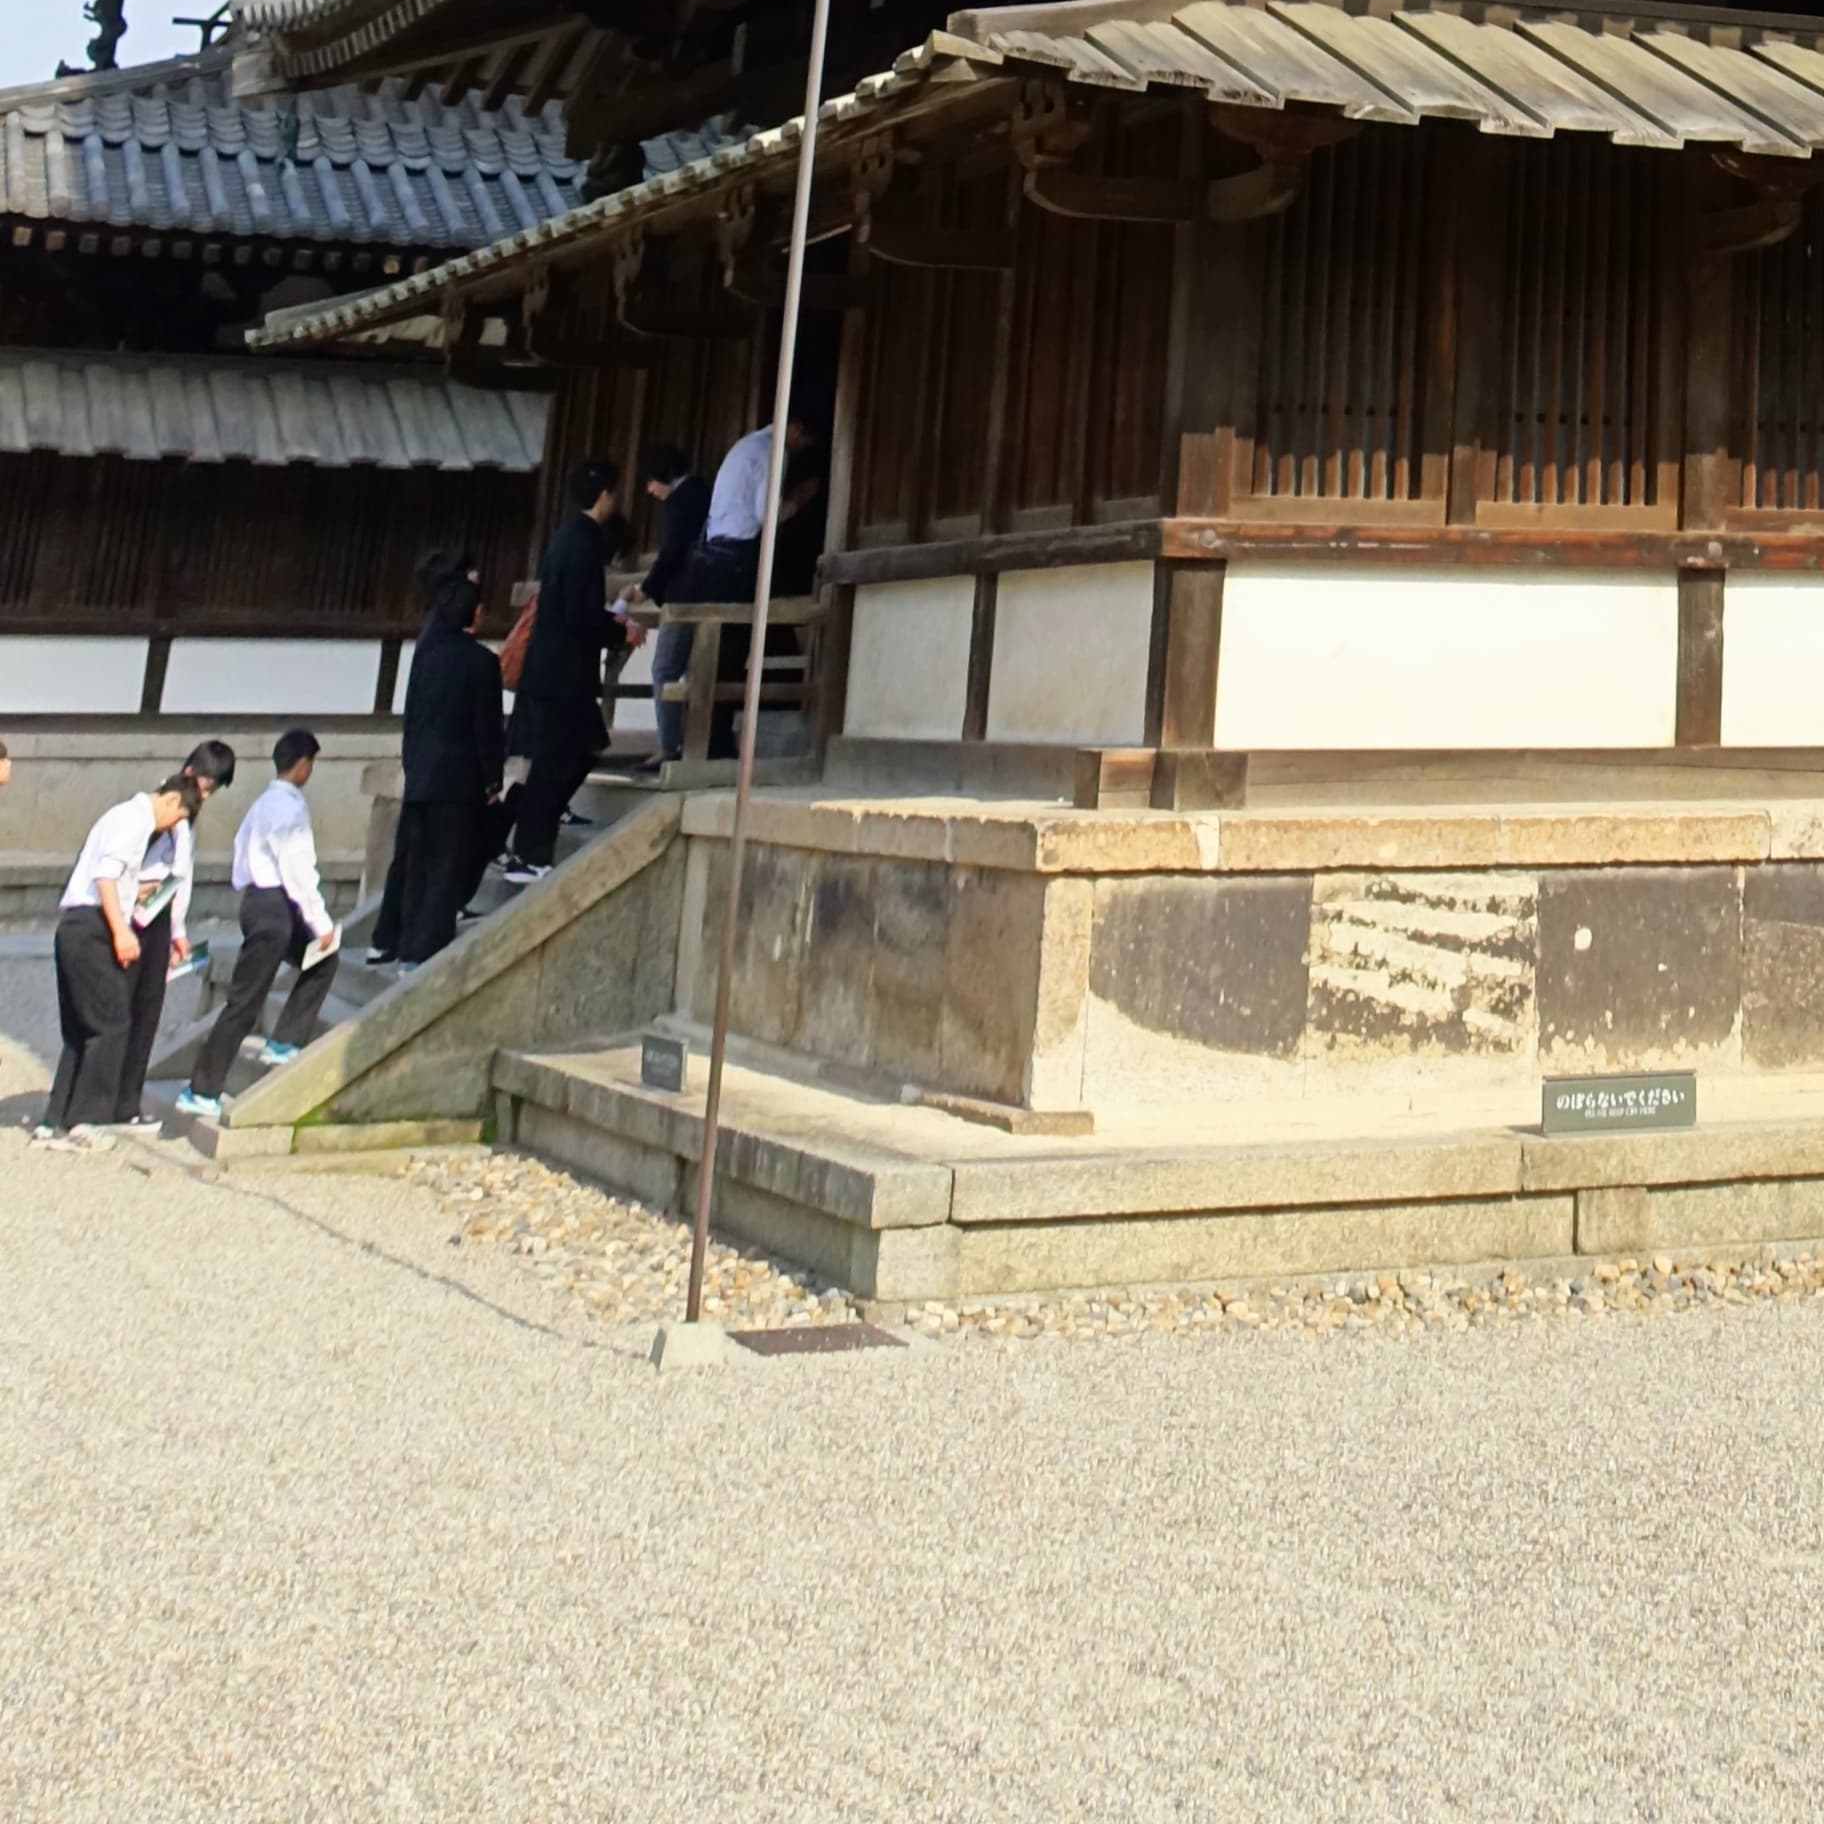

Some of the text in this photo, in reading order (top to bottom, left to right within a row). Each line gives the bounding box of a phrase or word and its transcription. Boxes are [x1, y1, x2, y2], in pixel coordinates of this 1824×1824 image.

[1556, 1087, 1685, 1110] のぼらないでください
